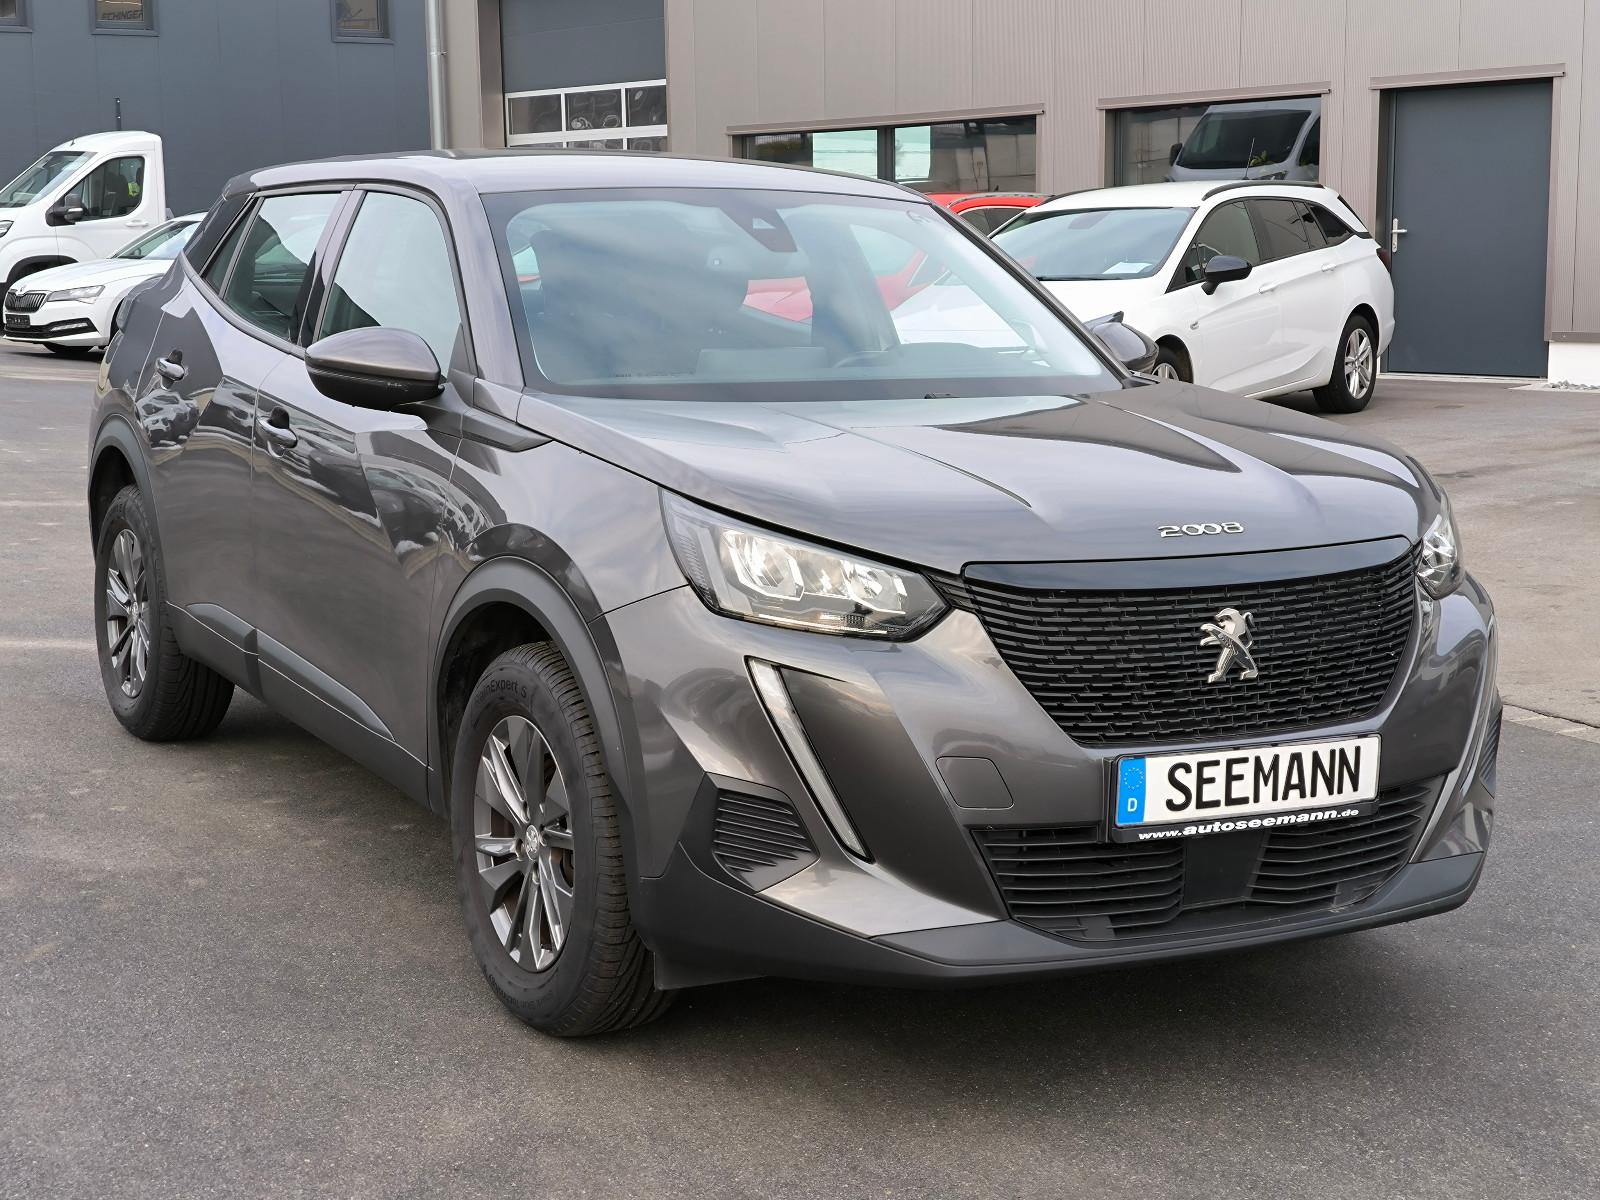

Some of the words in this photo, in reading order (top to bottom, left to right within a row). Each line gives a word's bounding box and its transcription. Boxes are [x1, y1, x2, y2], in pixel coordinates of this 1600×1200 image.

[1158, 522, 1244, 538] 2008
[1165, 745, 1361, 812] SEEMANN
[1127, 797, 1138, 812] D
[1138, 808, 1359, 840] www.autoseemann.de
